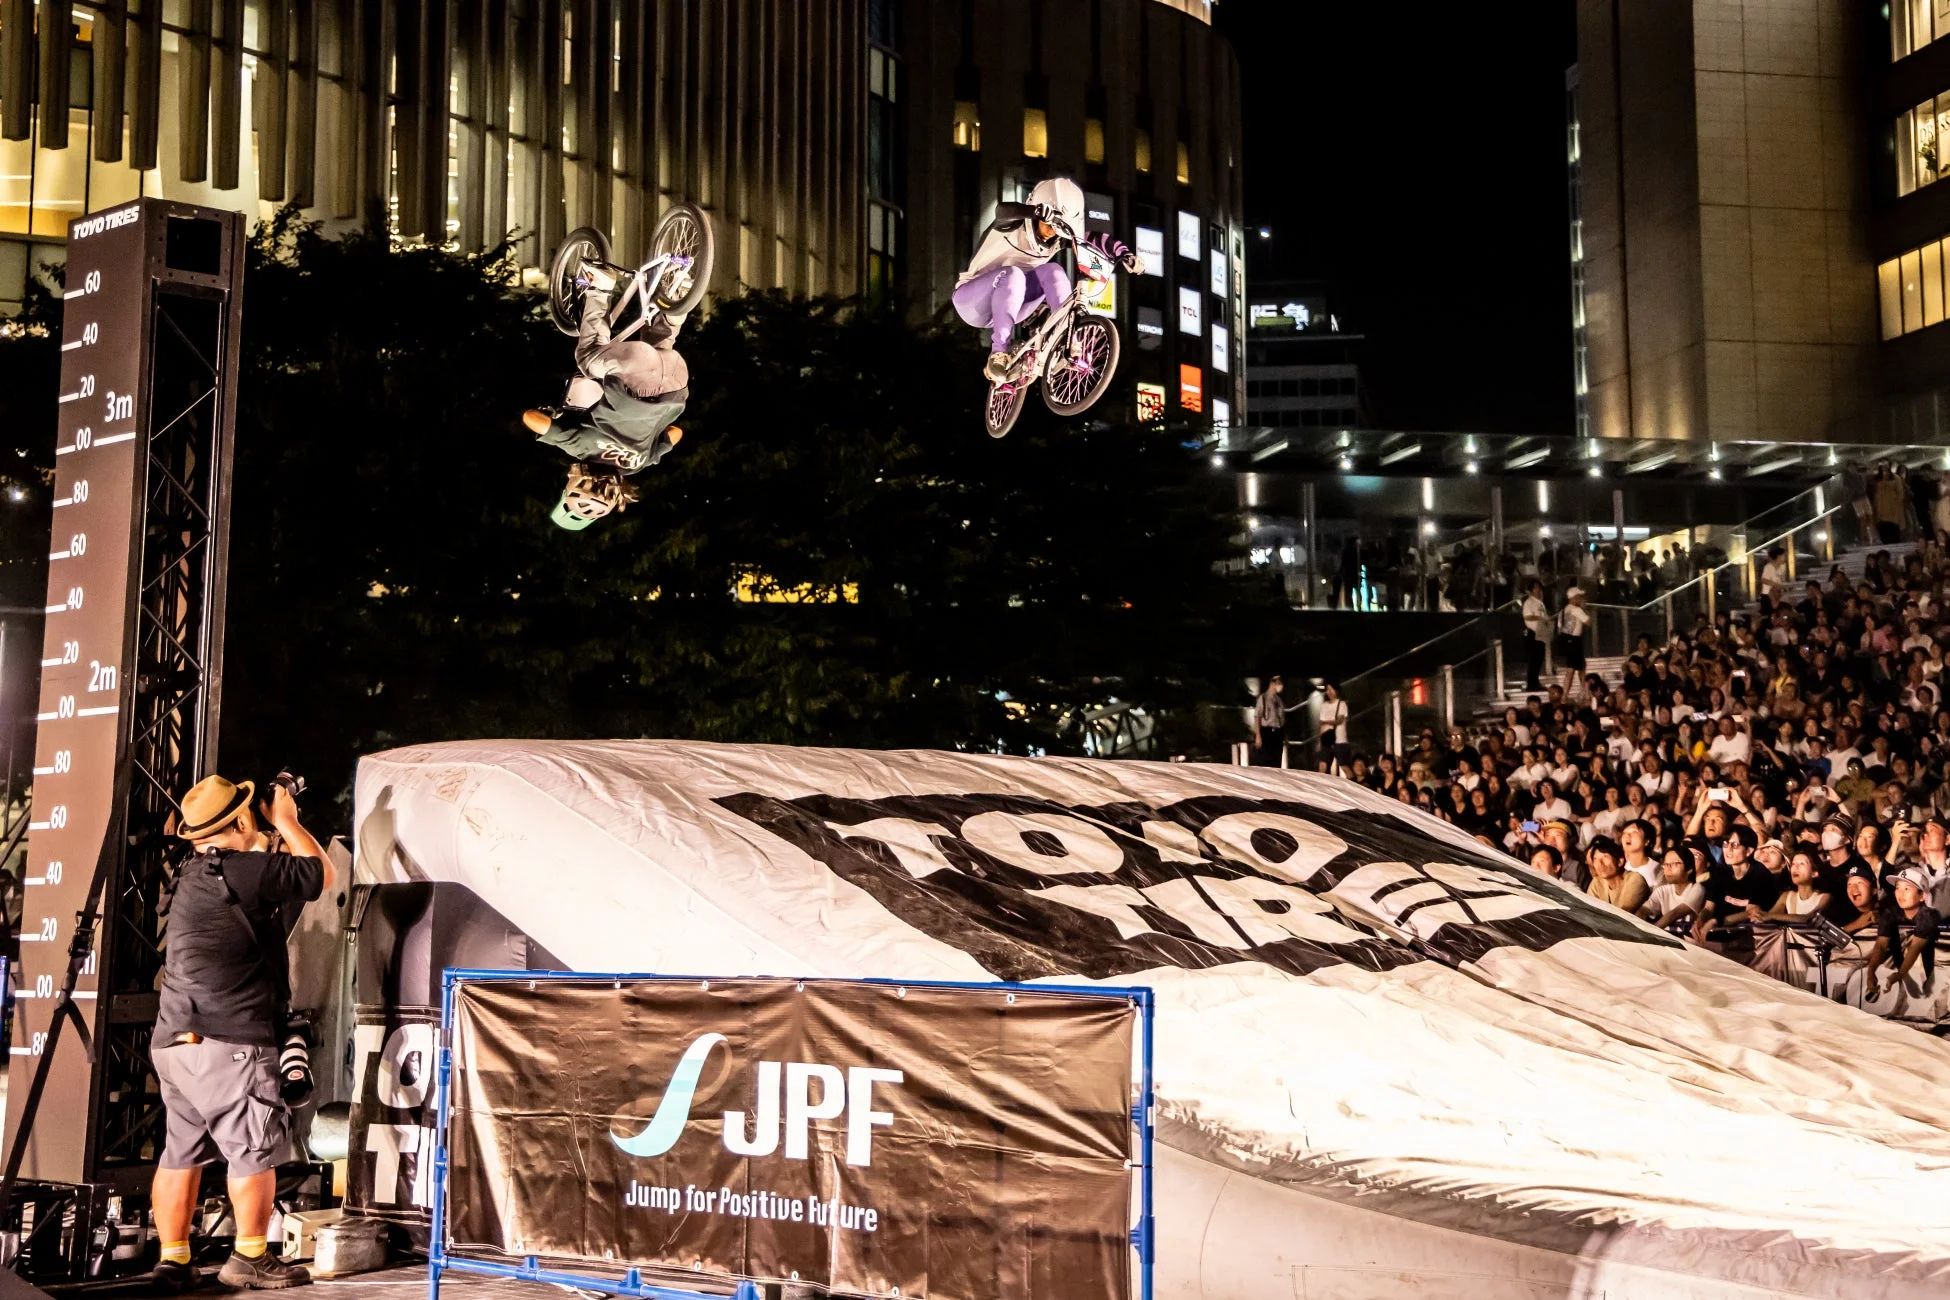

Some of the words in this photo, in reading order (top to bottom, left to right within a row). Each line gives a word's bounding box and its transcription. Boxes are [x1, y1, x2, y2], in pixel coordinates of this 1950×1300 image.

[73, 216, 105, 240] TOYO
[105, 205, 140, 231] TIRES
[85, 270, 101, 294] 60
[1088, 300, 1112, 310] Nikon
[1182, 306, 1198, 318] TCL
[82, 322, 99, 346] 40
[80, 374, 95, 399] 20
[104, 391, 133, 423] 3m
[76, 426, 92, 451] 00
[73, 479, 89, 504] 80
[70, 532, 87, 557] 60
[67, 586, 84, 611] 40
[63, 639, 80, 665] 20
[87, 659, 117, 693] 2m
[58, 694, 76, 720] 00
[54, 750, 72, 775] 80
[50, 804, 68, 830] 60
[46, 860, 64, 887] 40
[1023, 861, 1571, 951] TIRES
[41, 917, 58, 943] 20
[36, 974, 54, 999] 00
[723, 1060, 904, 1167] JPF
[625, 1179, 681, 1215] Jump
[685, 1184, 717, 1213] for
[718, 1186, 804, 1222] Positive
[807, 1195, 878, 1232] Future
